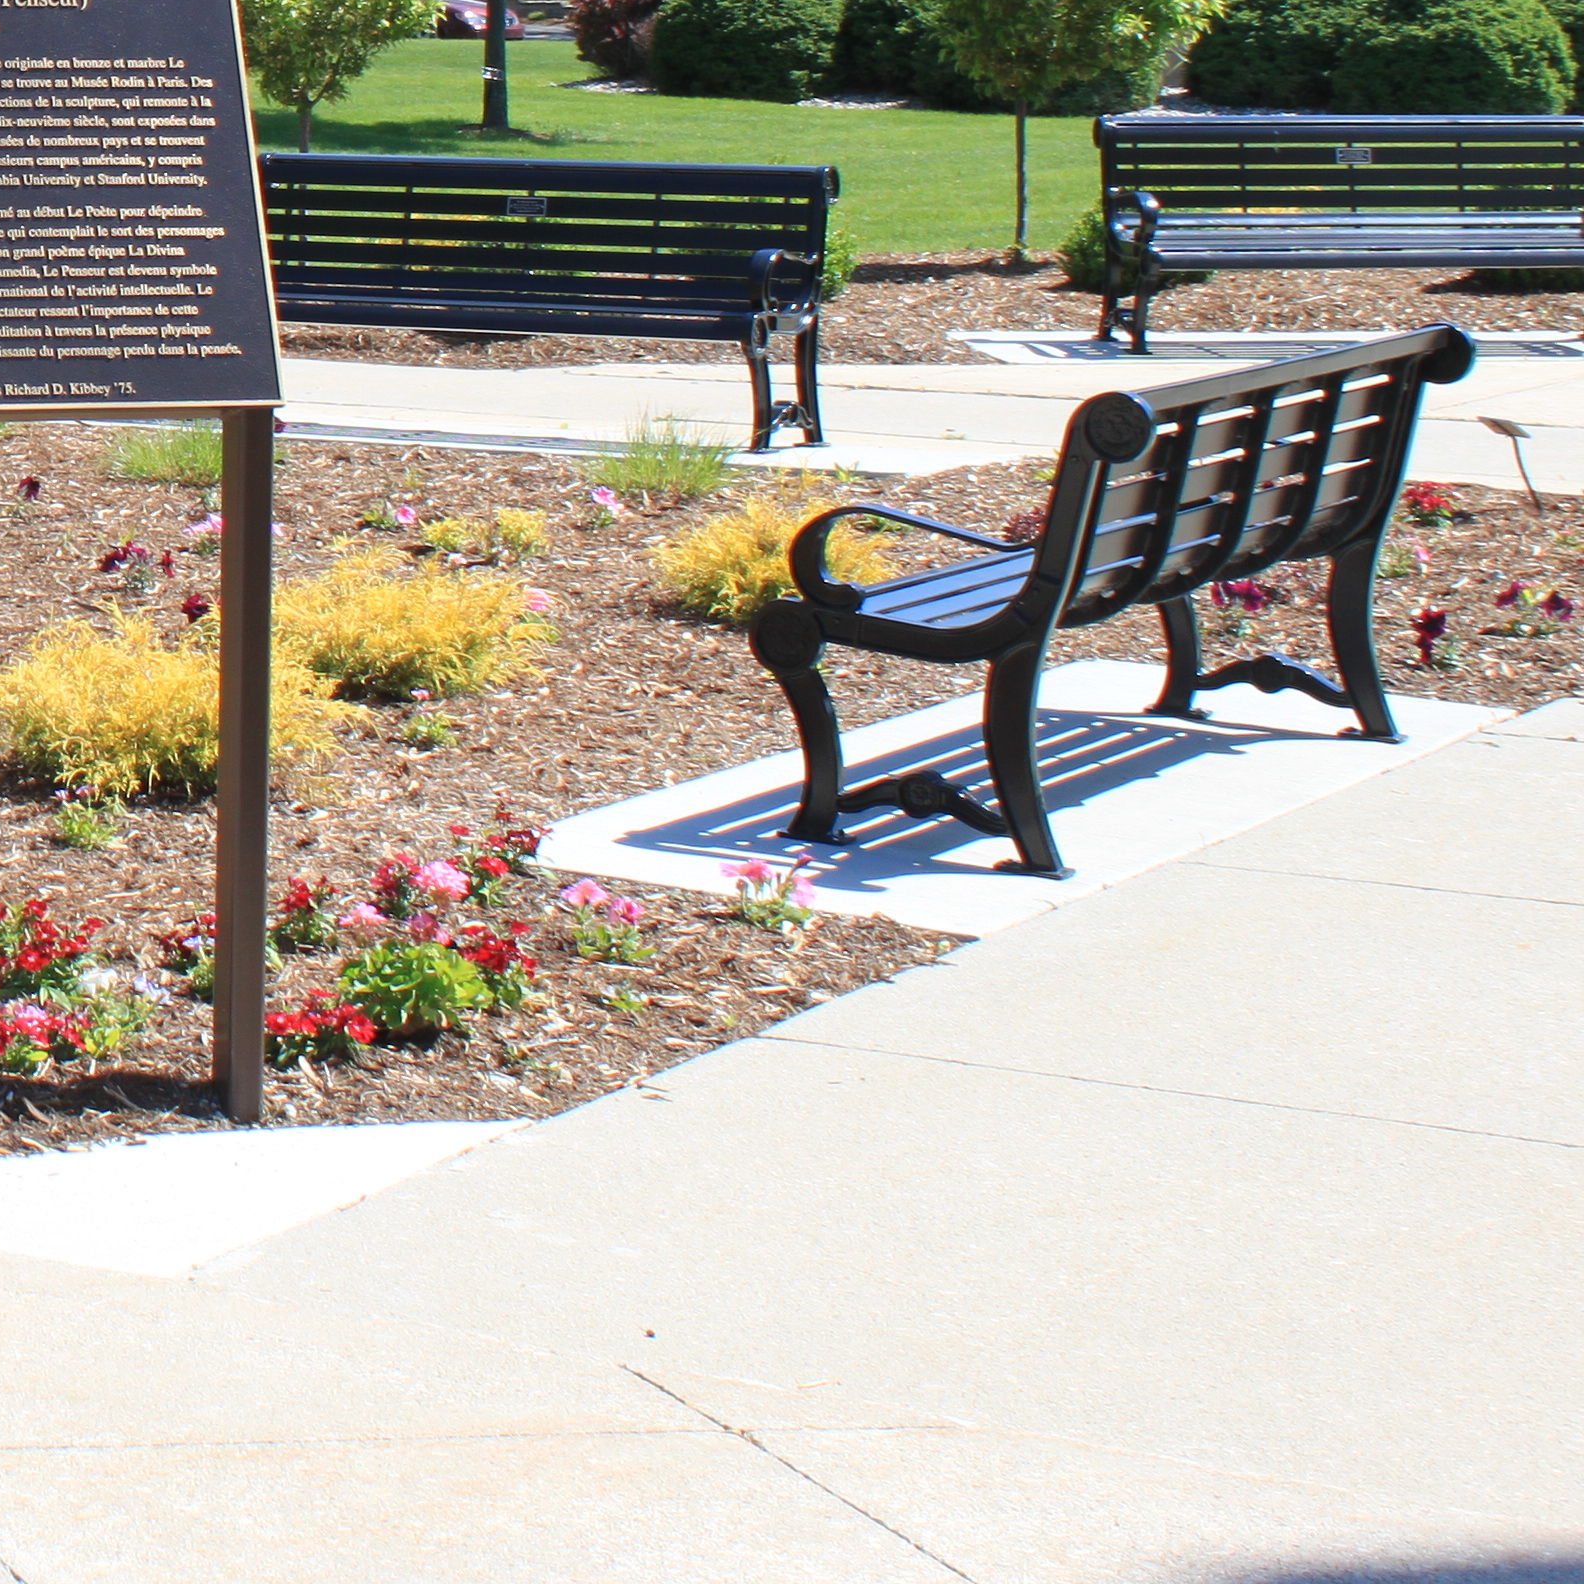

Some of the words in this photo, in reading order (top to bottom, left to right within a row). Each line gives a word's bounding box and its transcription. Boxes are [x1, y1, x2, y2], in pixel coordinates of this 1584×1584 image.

[4, 57, 55, 71] originale
[55, 59, 71, 69] en
[72, 57, 112, 69] bronze
[113, 57, 126, 69] et
[126, 57, 167, 69] marbre
[168, 57, 185, 69] Le
[26, 134, 42, 146] de
[43, 134, 101, 146] nombreux
[102, 137, 130, 148] pays
[130, 134, 143, 146] et
[144, 137, 158, 146] se
[158, 134, 206, 146] trouvent
[23, 173, 82, 188] University
[83, 173, 96, 185] et
[97, 173, 146, 185] Stanford
[147, 173, 208, 187] University.
[42, 265, 59, 277] Le
[61, 265, 107, 277] Penseur
[107, 264, 126, 276] est
[126, 264, 168, 276] devenu
[169, 264, 218, 278] symbole
[39, 345, 55, 357] du
[56, 347, 122, 359] personnage
[123, 344, 156, 358] perdu
[157, 344, 185, 355] dans
[186, 343, 199, 355] la
[4, 383, 51, 395] Richard
[52, 382, 67, 395] D.
[69, 382, 112, 398] Kibbey
